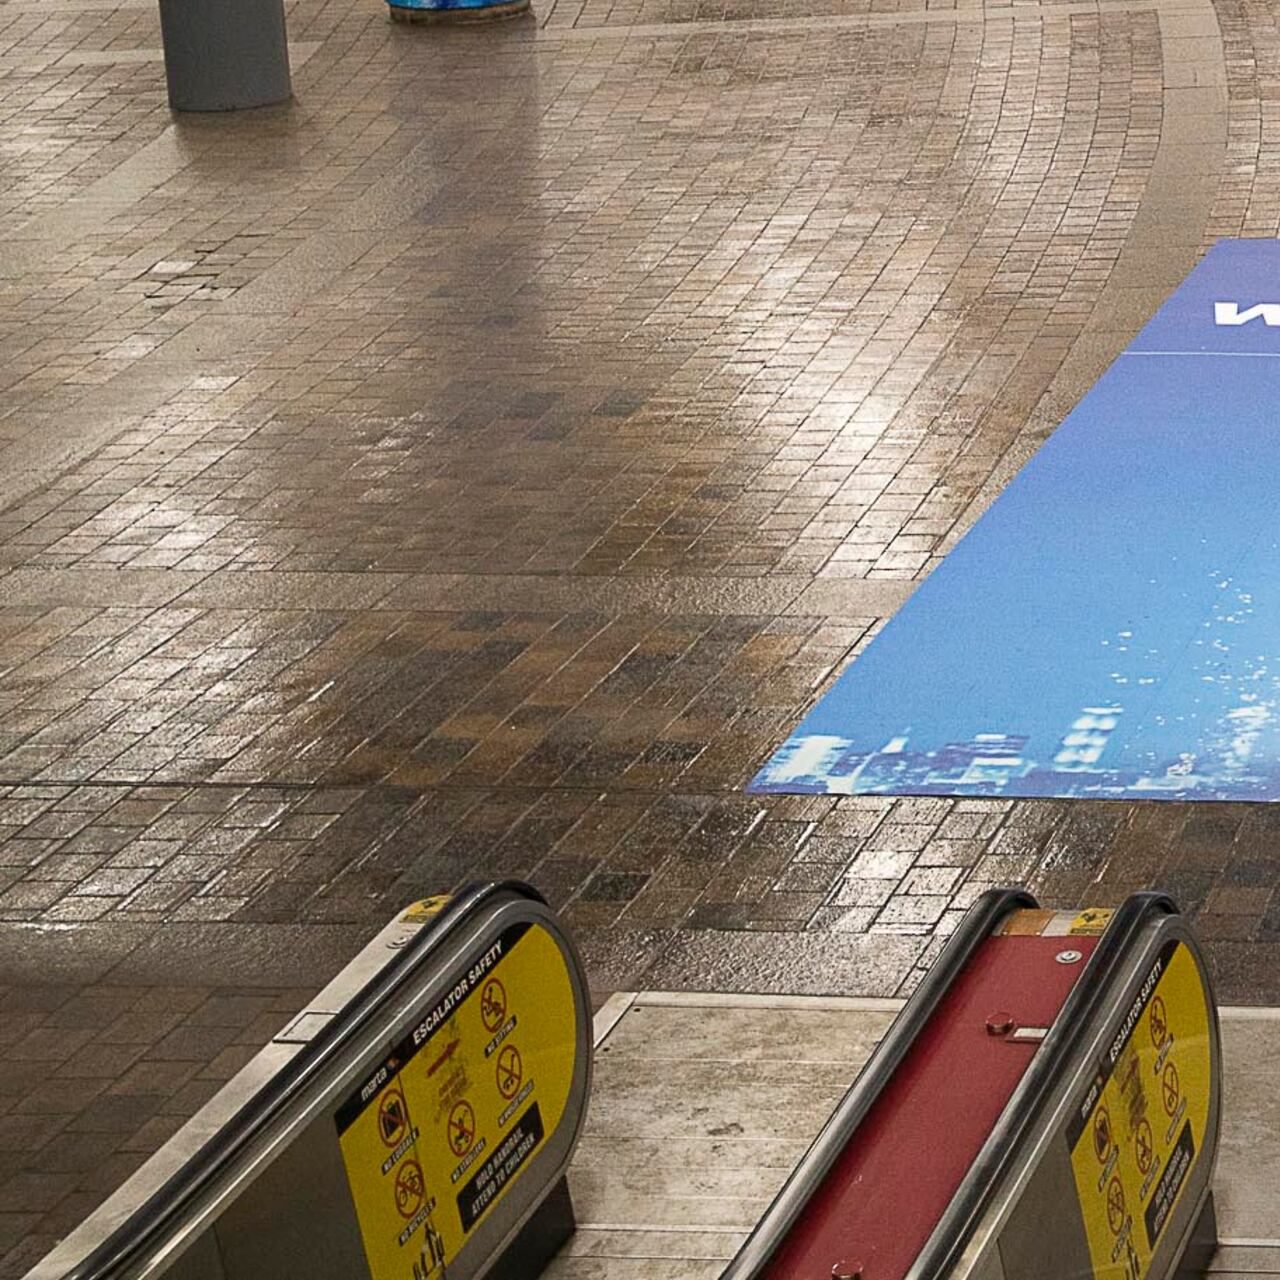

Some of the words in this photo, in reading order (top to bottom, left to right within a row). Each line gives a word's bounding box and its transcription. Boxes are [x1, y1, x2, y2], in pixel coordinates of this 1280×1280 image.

[361, 1067, 388, 1100] marta
[412, 979, 469, 1046] ESCALATOR
[468, 939, 502, 985] SAFETY
[1109, 998, 1143, 1063] ESCALATOR
[1141, 958, 1163, 1002] SAFETY
